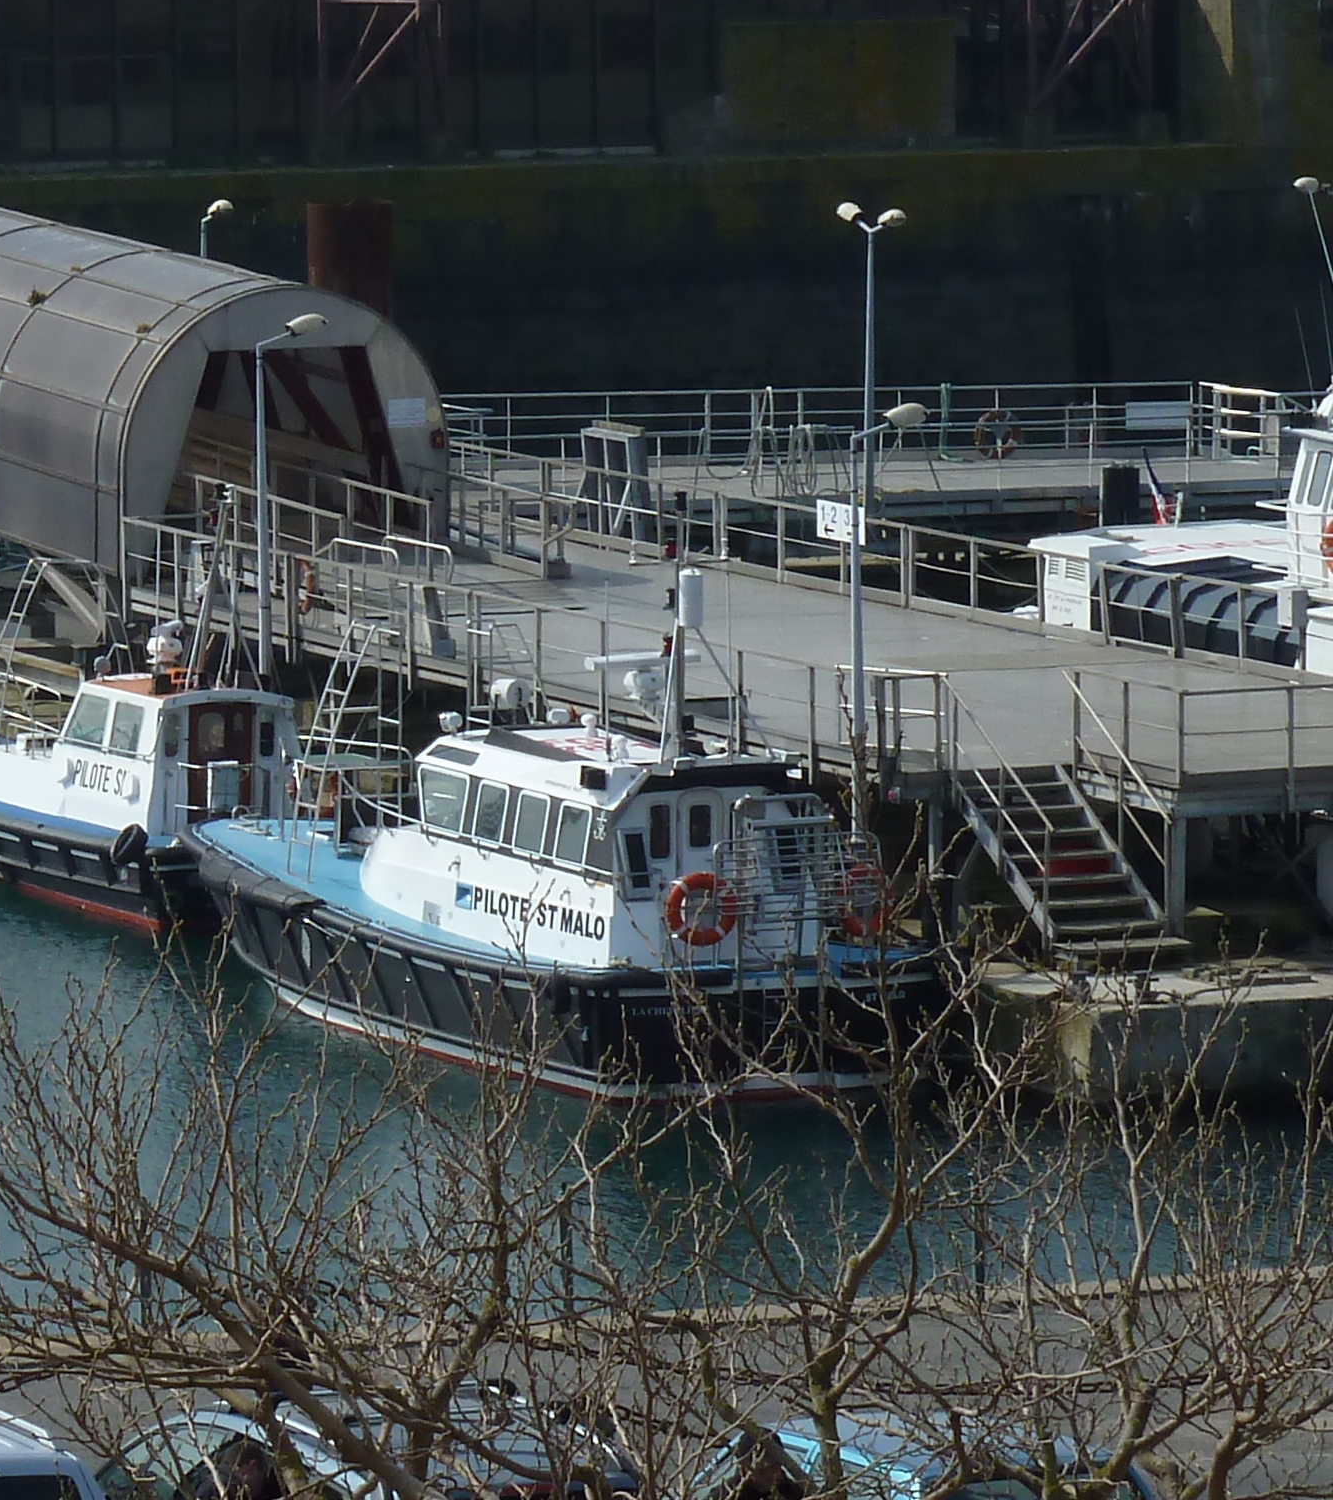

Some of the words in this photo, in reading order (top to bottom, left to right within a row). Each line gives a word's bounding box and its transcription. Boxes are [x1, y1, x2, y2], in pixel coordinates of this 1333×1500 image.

[72, 758, 113, 793] PILOTE
[473, 886, 531, 923] PILOTE
[537, 901, 559, 930] ST
[559, 907, 606, 941] MALO
